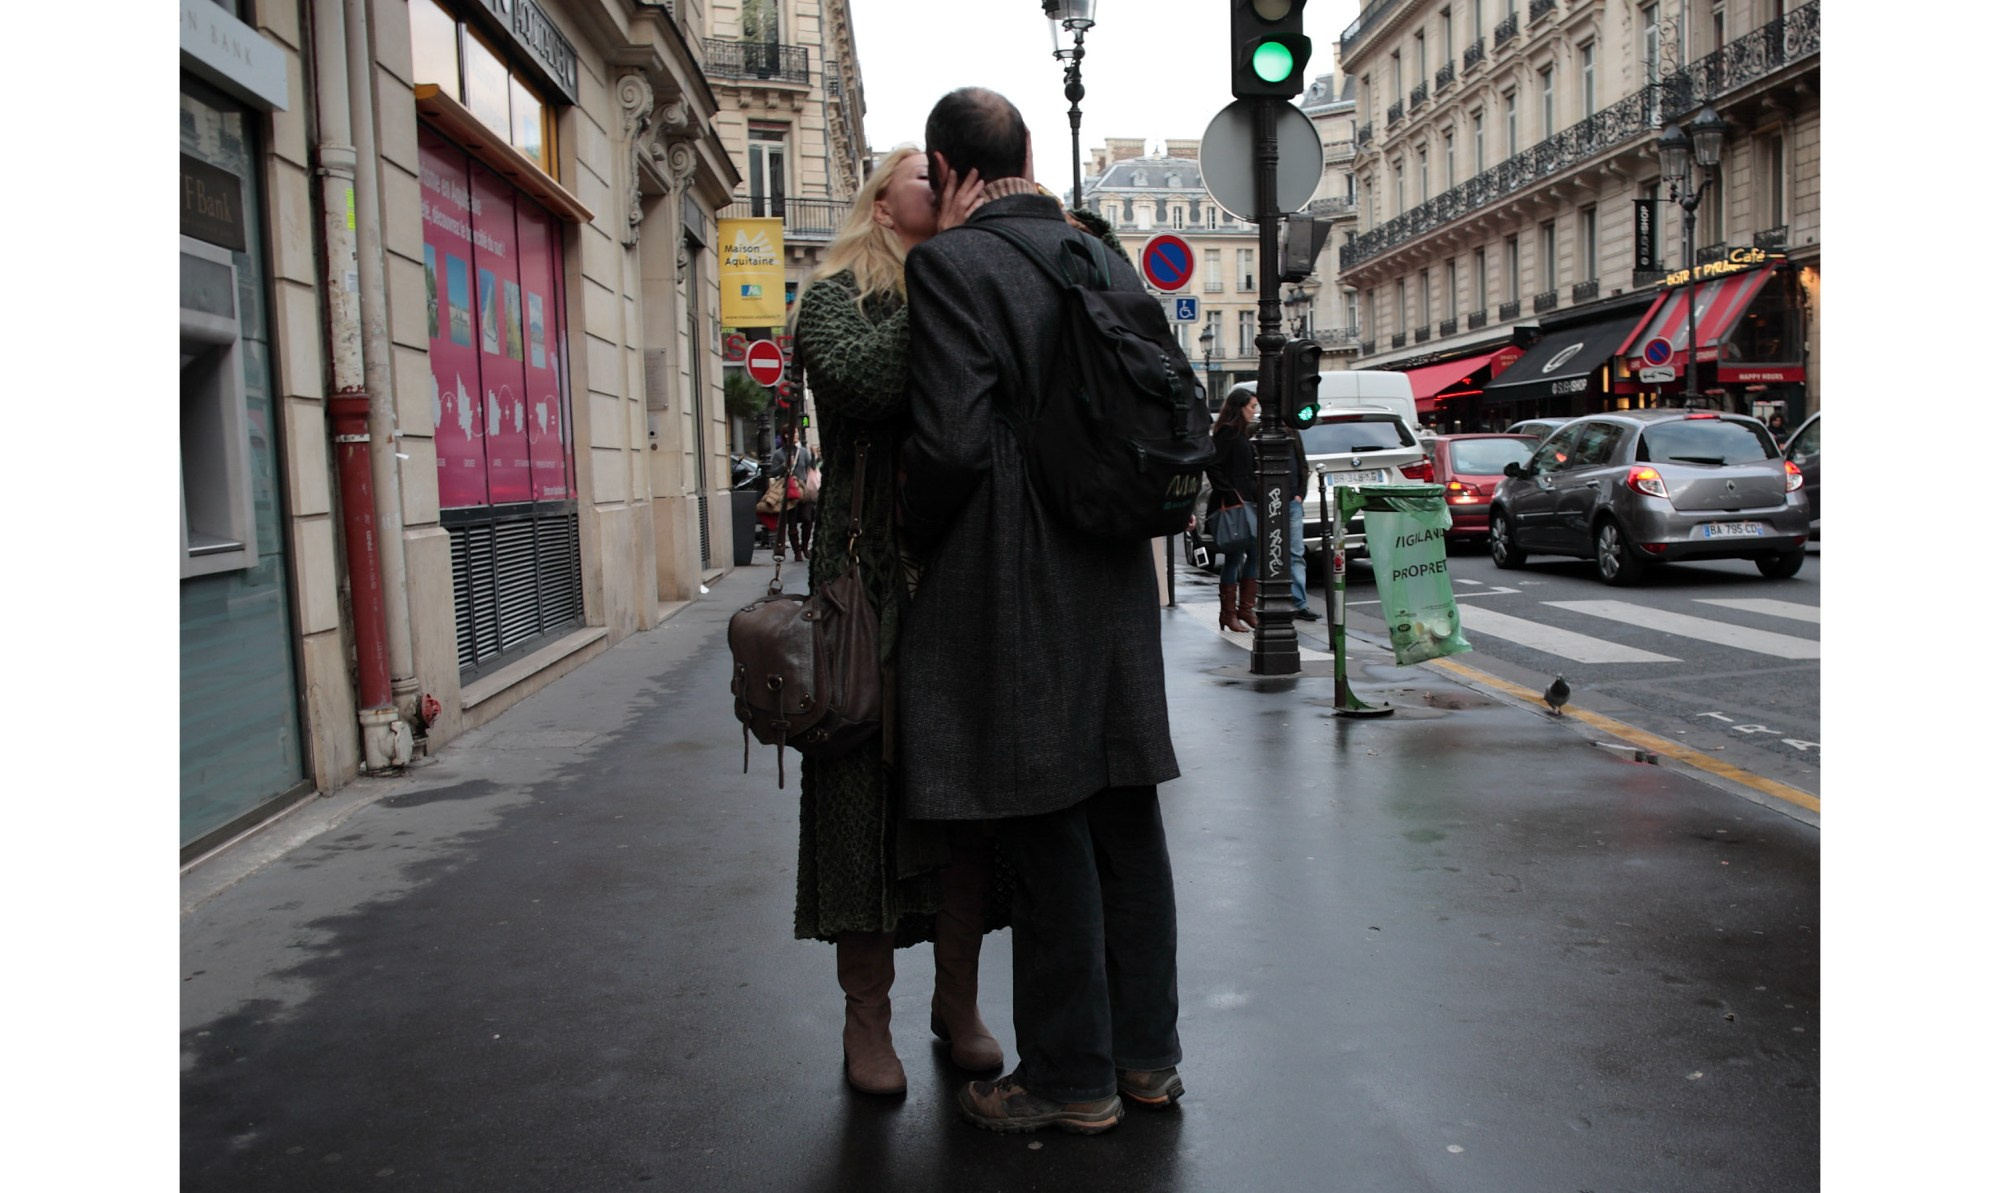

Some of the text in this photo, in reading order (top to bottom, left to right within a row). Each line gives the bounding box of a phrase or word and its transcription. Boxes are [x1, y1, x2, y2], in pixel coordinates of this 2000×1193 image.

[211, 23, 253, 67] BANK
[196, 179, 233, 223] Bank
[724, 244, 760, 253] Maison
[1730, 247, 1765, 263] Café
[725, 256, 774, 267] Aquitaine
[1666, 266, 1702, 286] BISTRT
